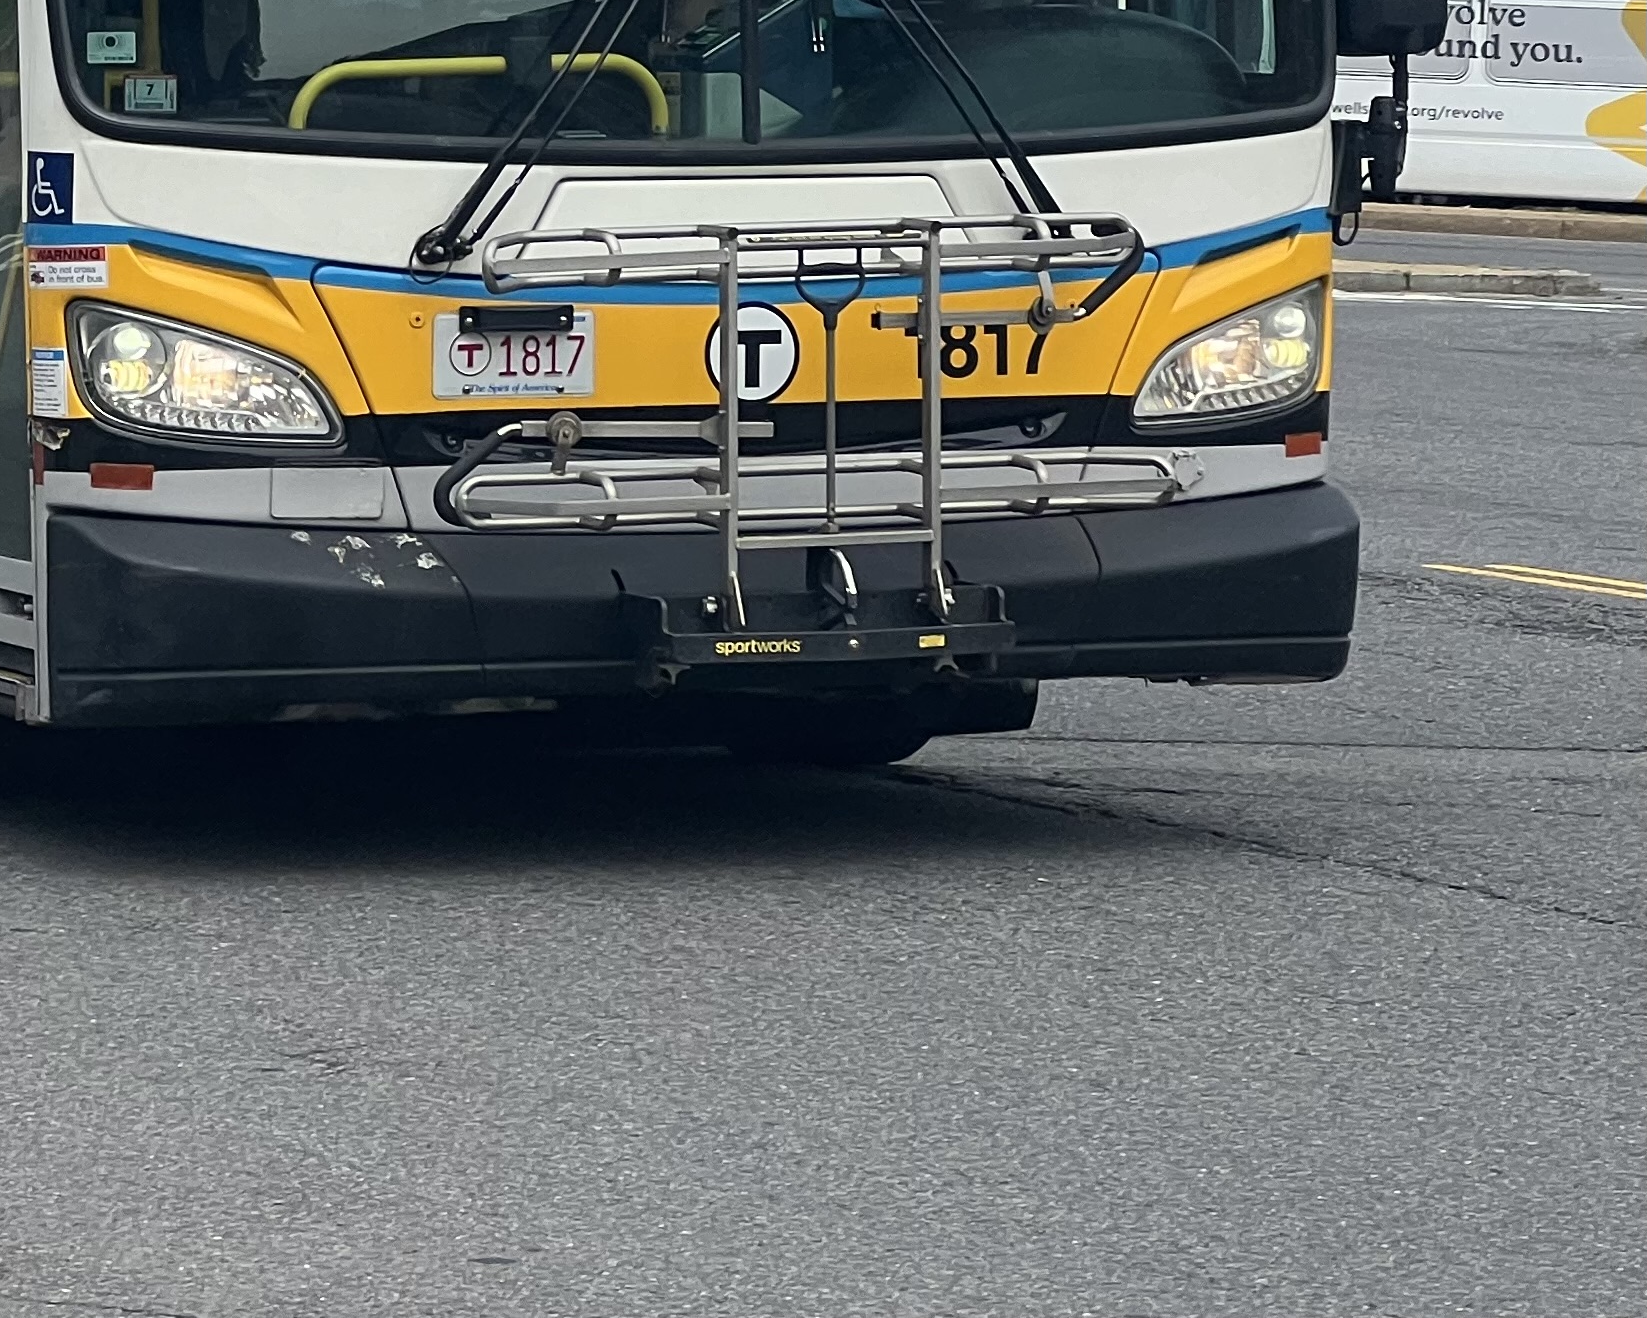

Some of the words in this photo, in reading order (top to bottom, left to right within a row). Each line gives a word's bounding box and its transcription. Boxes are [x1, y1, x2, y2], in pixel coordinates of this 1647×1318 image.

[1416, 34, 1501, 59] und
[1509, 41, 1583, 67] you.
[37, 246, 101, 261] WARNING
[48, 264, 58, 274] Do
[59, 265, 72, 274] not
[74, 265, 96, 274] cross
[56, 273, 74, 283] front
[75, 273, 84, 283] of
[457, 343, 483, 368] T
[498, 334, 585, 377] 1817
[737, 329, 783, 388] T
[487, 383, 510, 395] Spirit
[511, 382, 520, 394] of
[714, 638, 802, 657] sportworks
